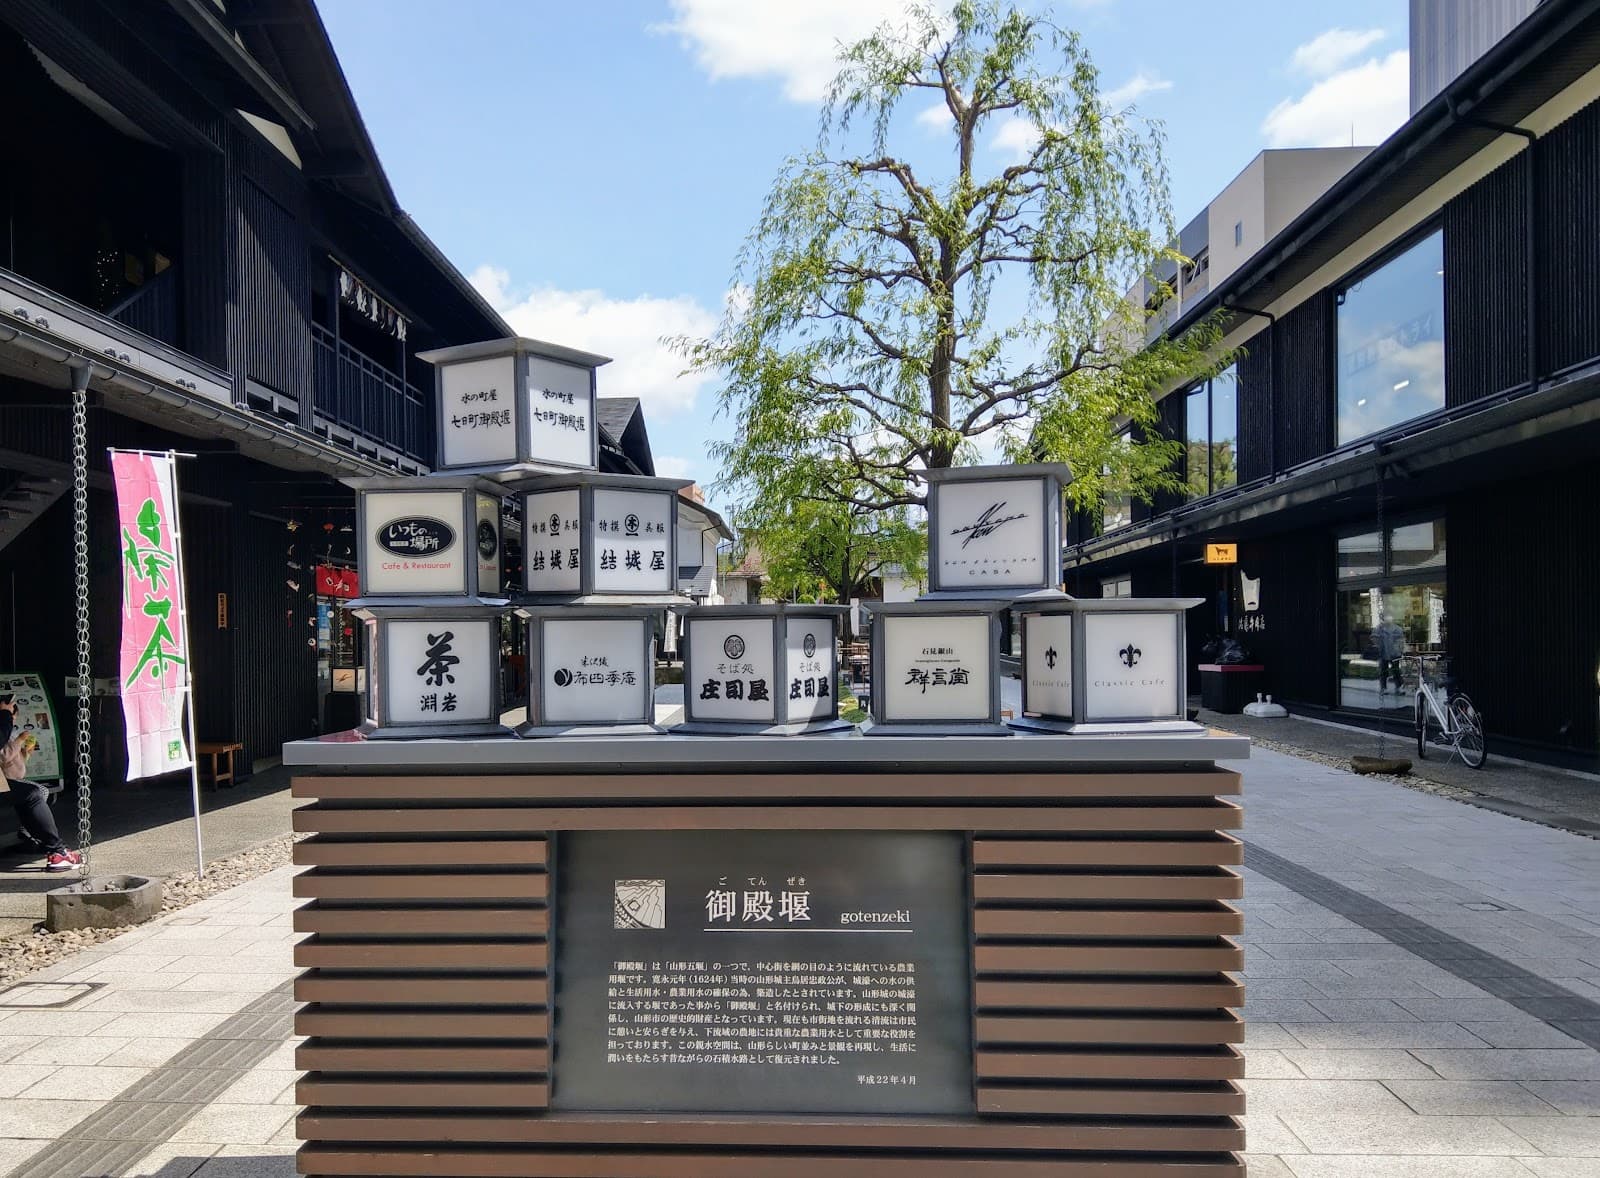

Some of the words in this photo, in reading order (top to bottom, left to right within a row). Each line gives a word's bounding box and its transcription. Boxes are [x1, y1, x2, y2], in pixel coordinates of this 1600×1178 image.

[461, 389, 498, 404] 水の町屋
[542, 388, 574, 405] 水の町屋
[451, 409, 511, 429] 七日町御殿堰
[534, 407, 585, 432] 七日町御殿堰
[409, 535, 440, 551] 場所
[382, 562, 401, 570] Cafe
[403, 562, 409, 570] &
[411, 561, 451, 570] Restaurant
[533, 548, 579, 571] 結城屋
[600, 549, 665, 571] 結城屋
[417, 631, 460, 687] 茶
[800, 661, 822, 673] そば処
[716, 663, 754, 674] そば処
[573, 670, 636, 687] 布四季庵
[905, 667, 970, 694] 群言堂
[1094, 680, 1135, 688] Classic
[700, 679, 770, 701] 庄司屋
[790, 676, 830, 700] 庄司屋
[718, 876, 727, 885] ご
[747, 876, 767, 886] てん
[786, 876, 807, 886] ぜき
[705, 889, 812, 923] 御殿堰
[840, 909, 911, 924] gotenzeki
